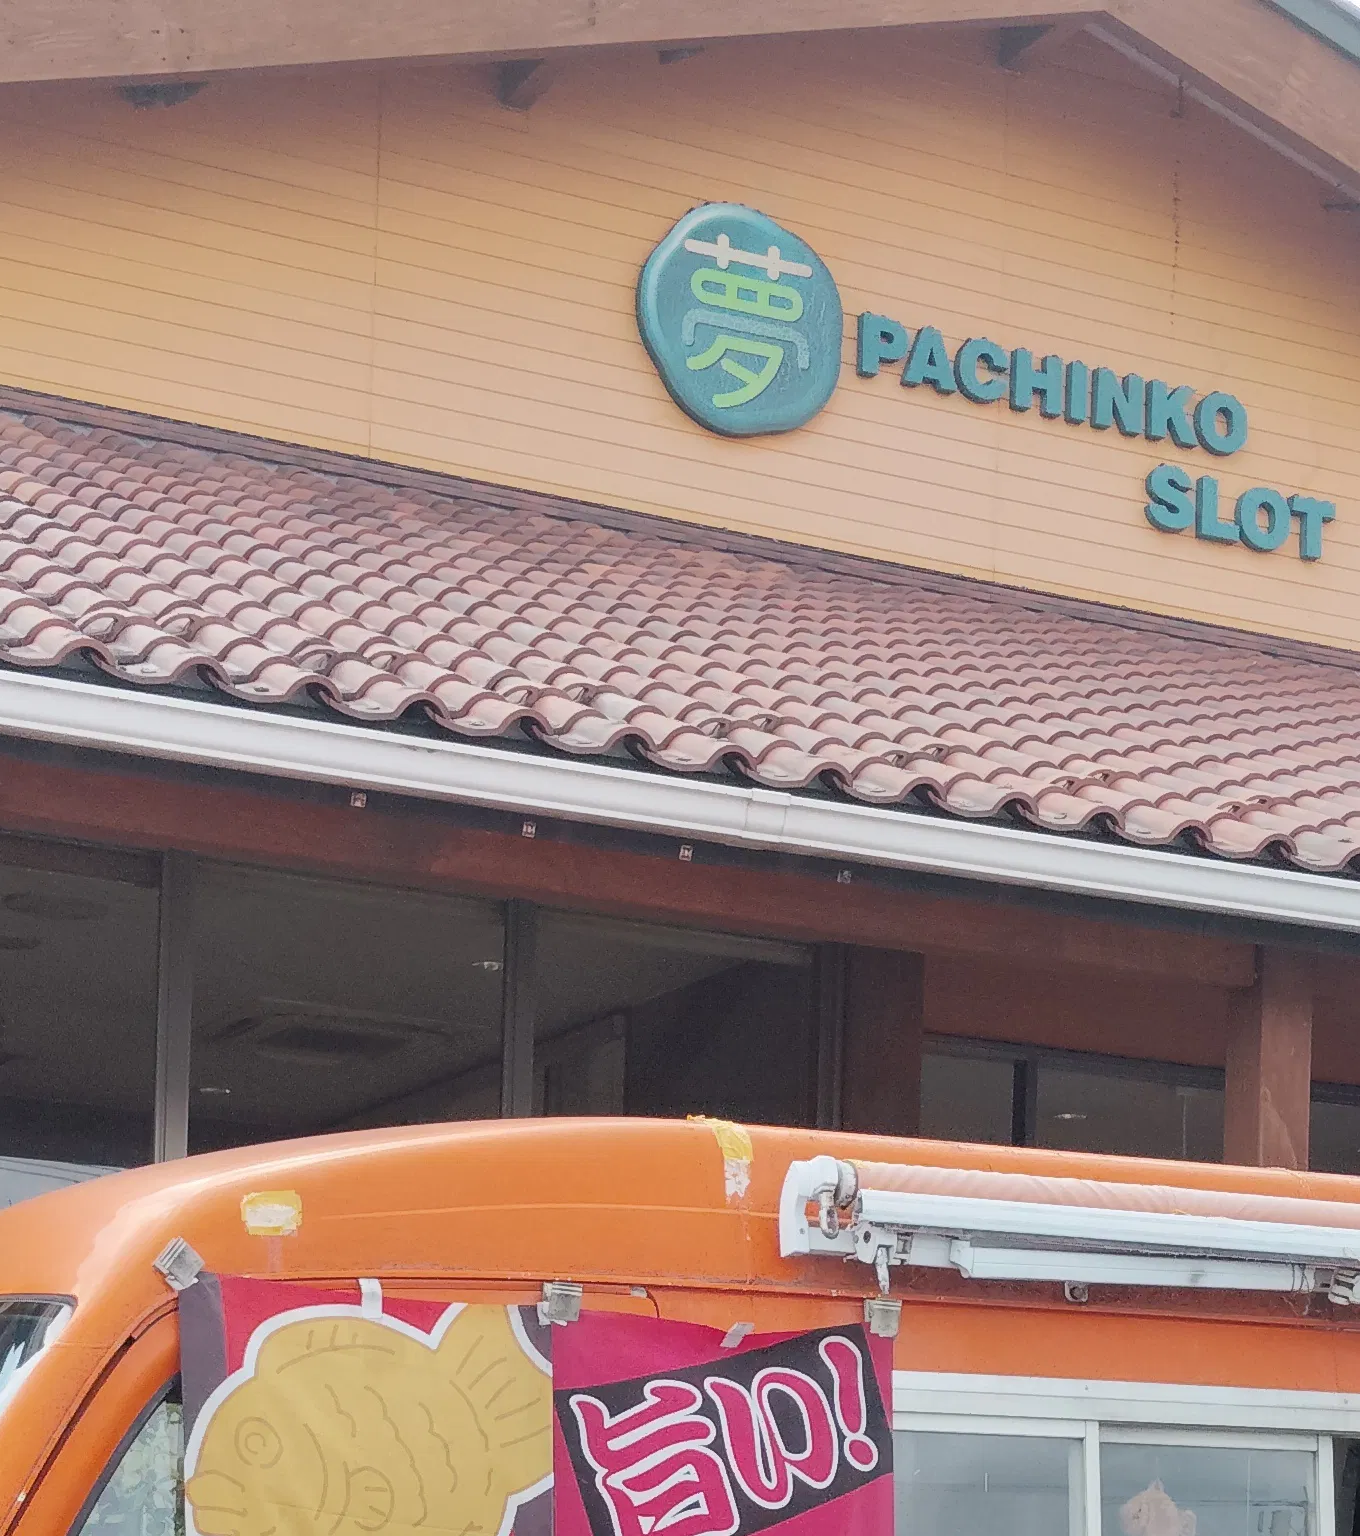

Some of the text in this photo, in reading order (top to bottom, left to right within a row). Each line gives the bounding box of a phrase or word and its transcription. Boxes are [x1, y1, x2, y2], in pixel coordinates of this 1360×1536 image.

[685, 233, 812, 408] 夢
[856, 309, 1249, 456] PACHINKO
[1144, 463, 1337, 562] SLOT
